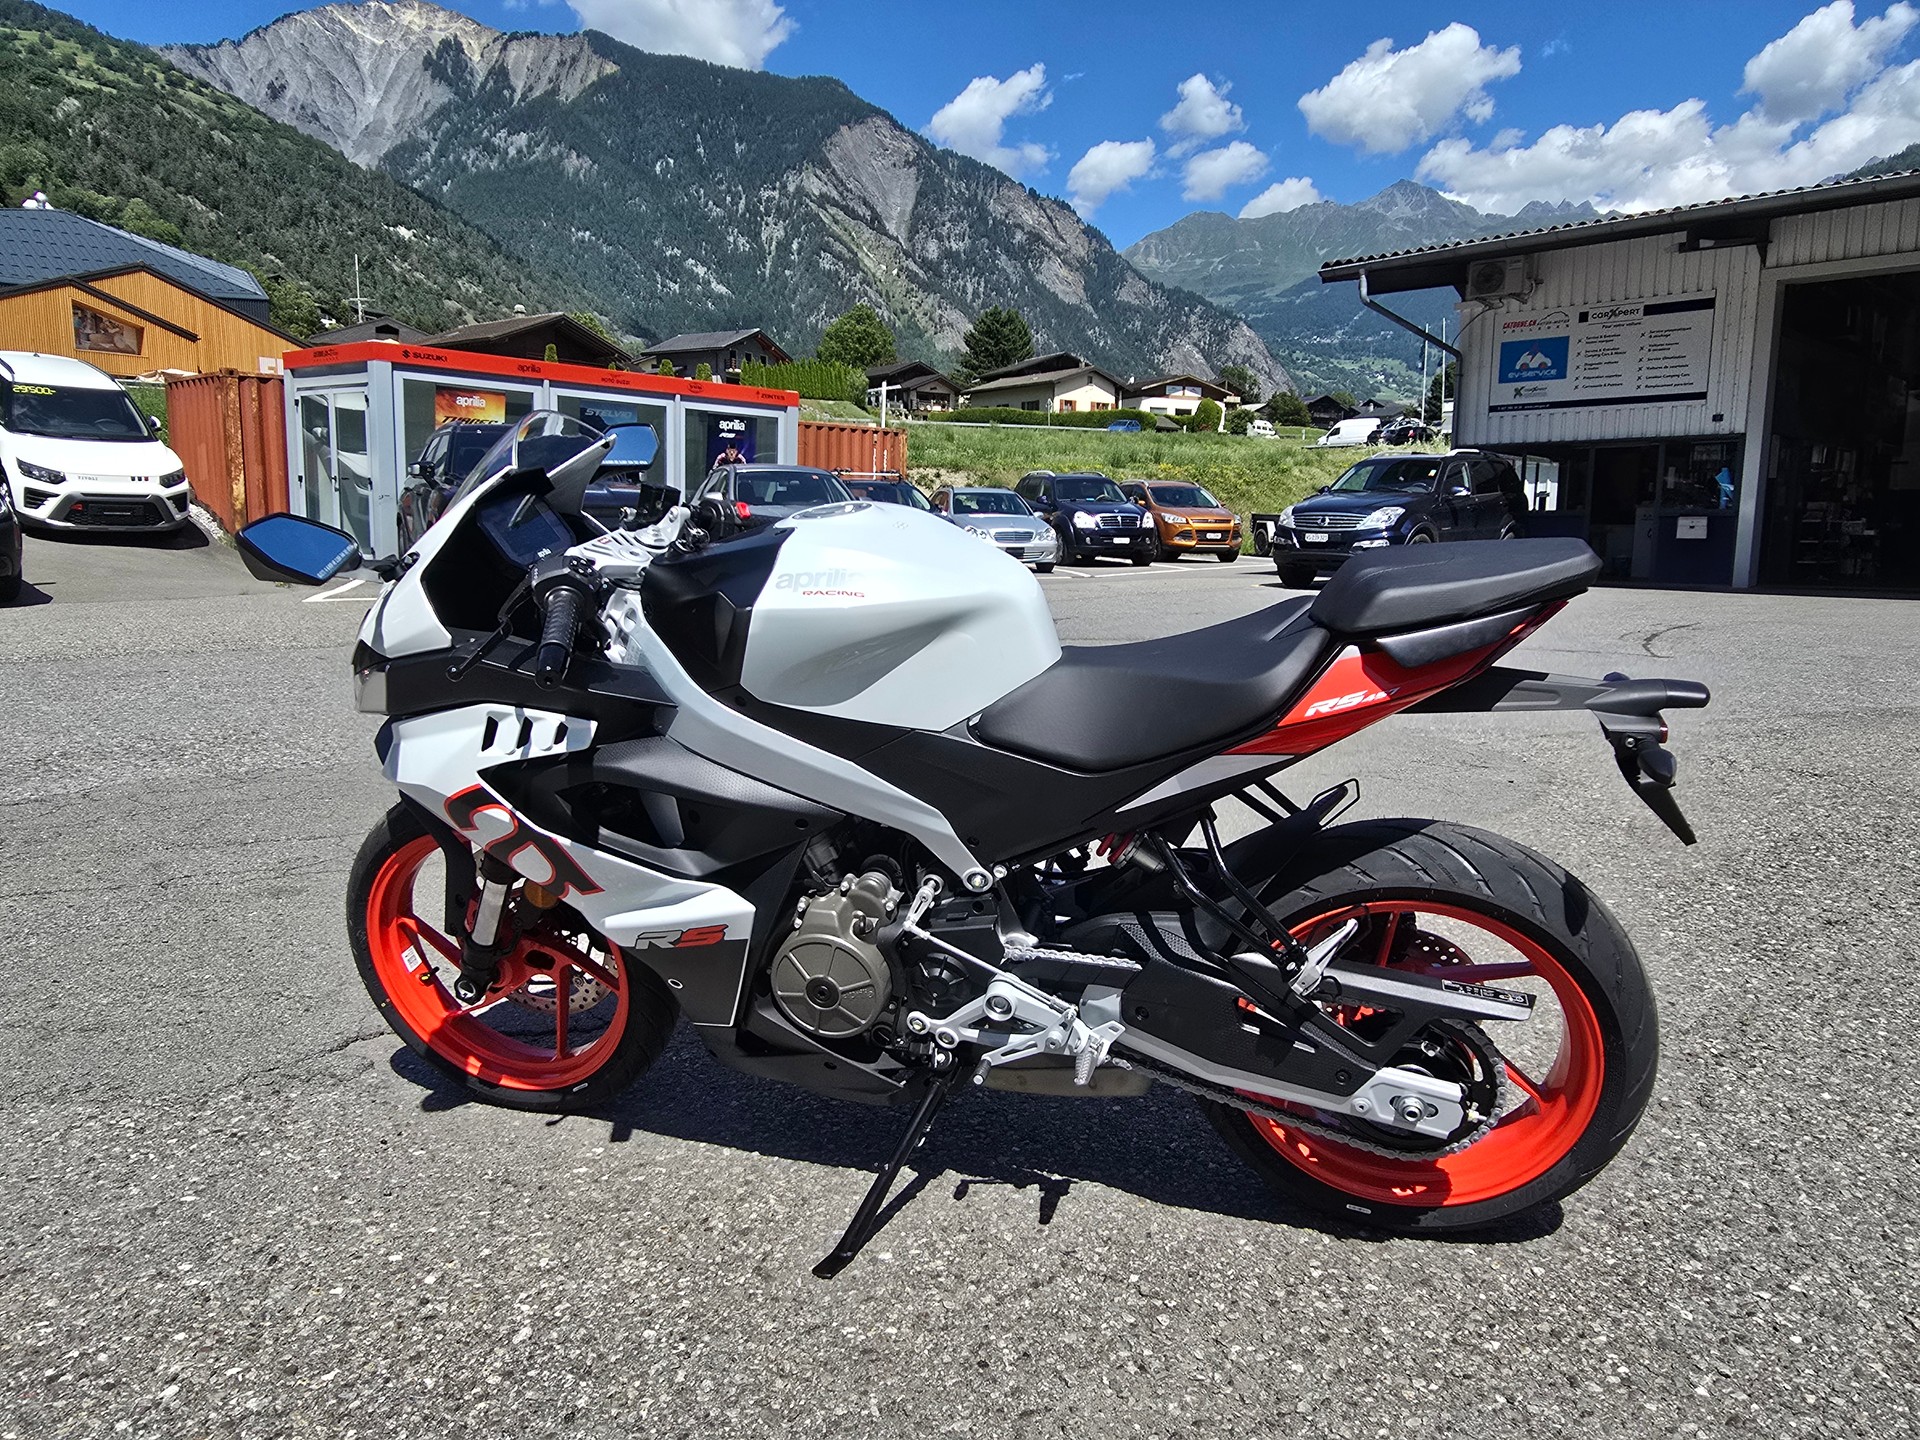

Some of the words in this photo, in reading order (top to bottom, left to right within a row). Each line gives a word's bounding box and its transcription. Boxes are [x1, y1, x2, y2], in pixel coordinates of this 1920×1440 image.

[413, 352, 448, 362] SUZUKI
[456, 395, 486, 408] aprilia
[585, 407, 632, 418] STELVIO
[719, 419, 747, 431] aprilia
[802, 590, 865, 598] RACING
[1304, 689, 1369, 717] RS
[635, 923, 729, 950] RS
